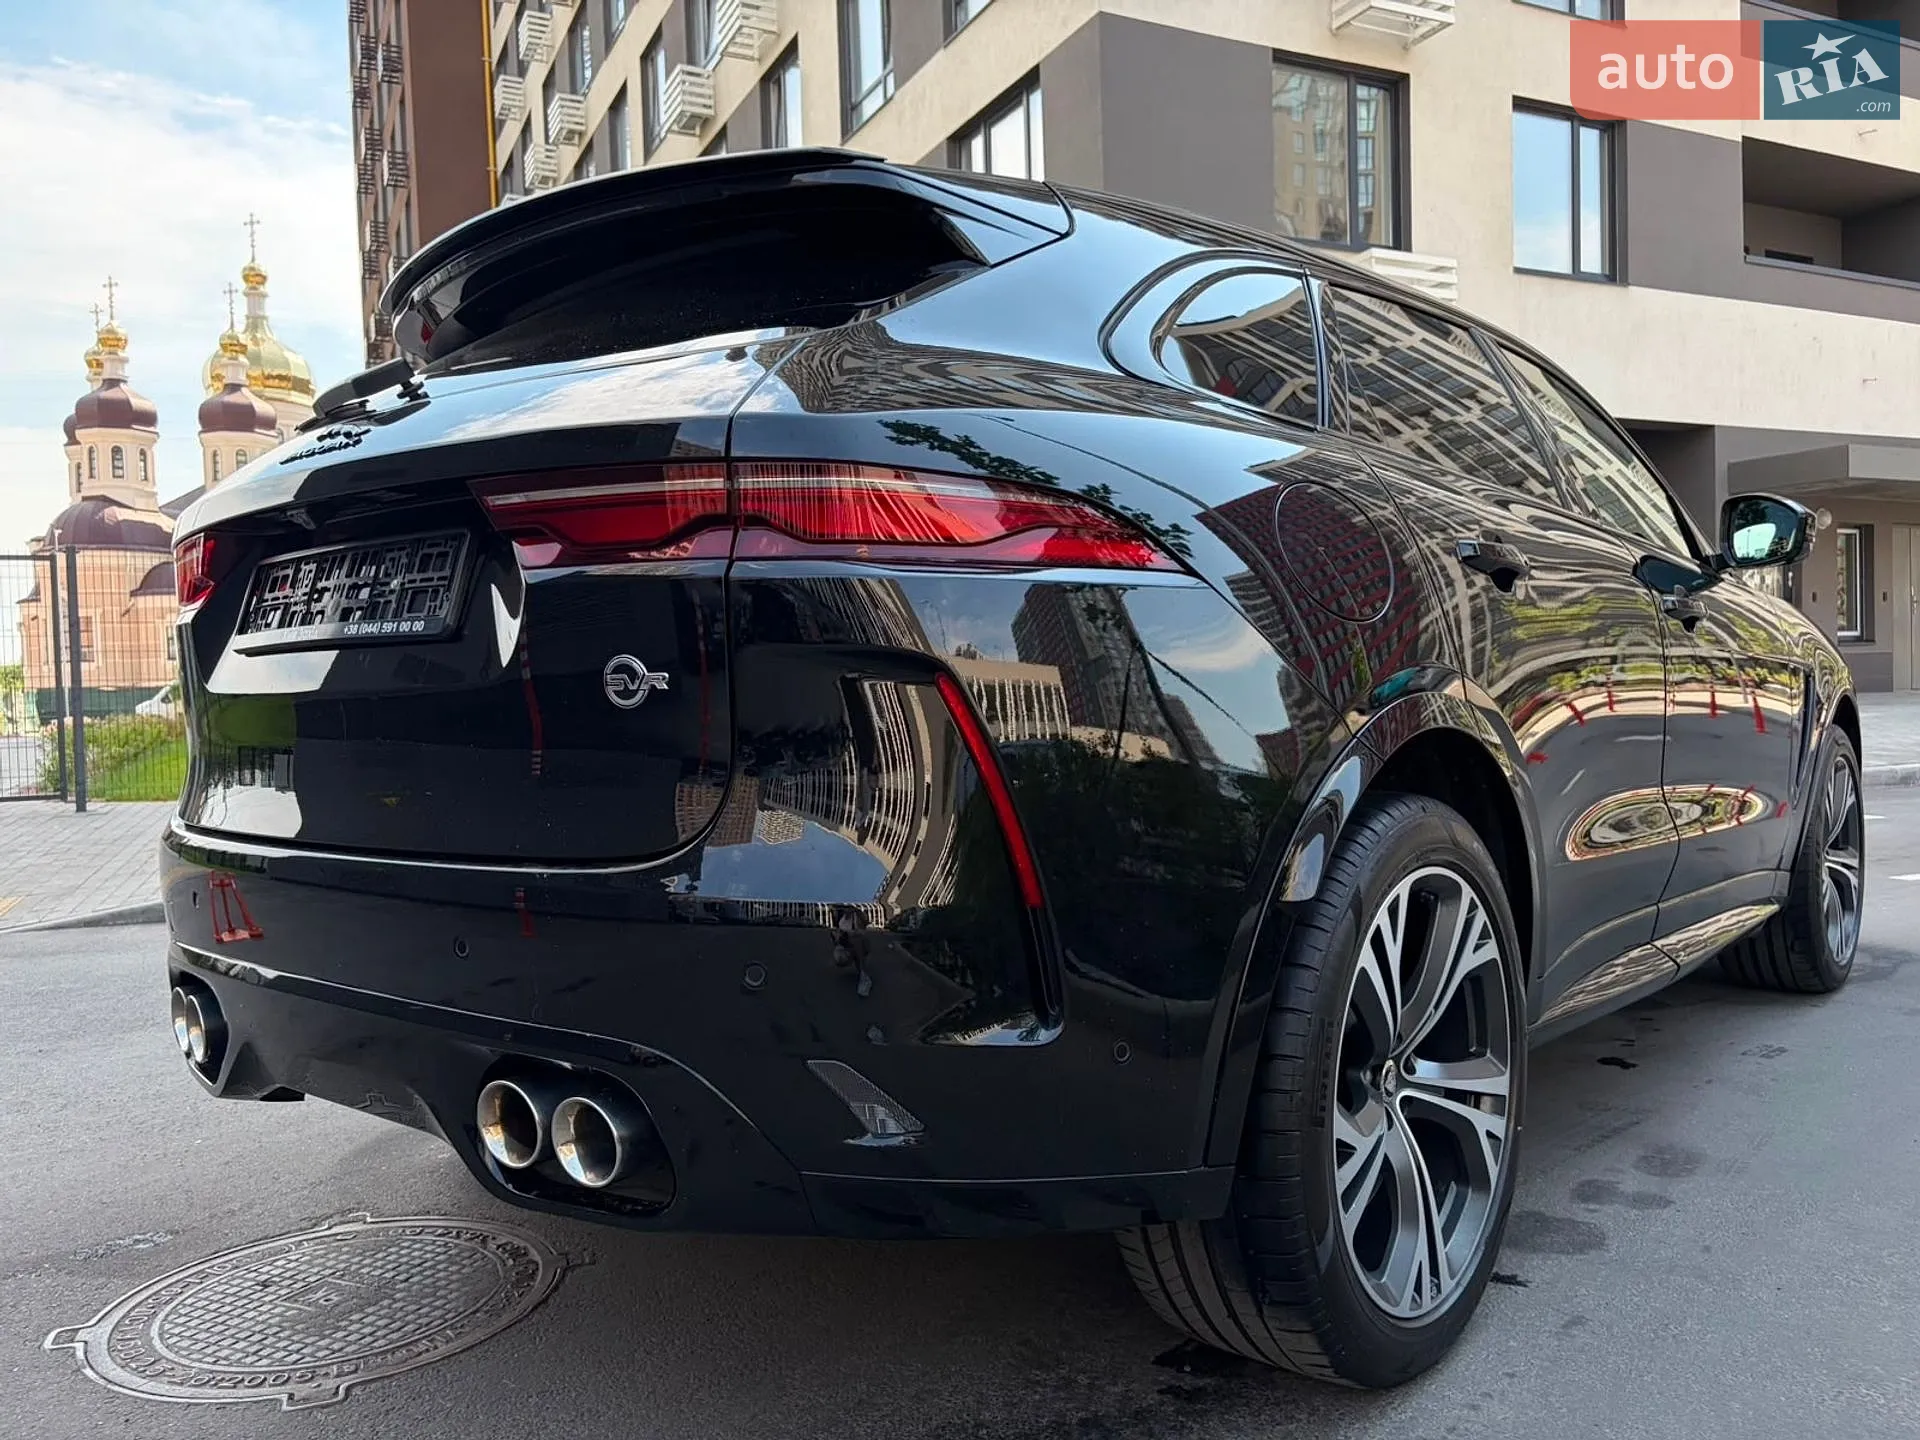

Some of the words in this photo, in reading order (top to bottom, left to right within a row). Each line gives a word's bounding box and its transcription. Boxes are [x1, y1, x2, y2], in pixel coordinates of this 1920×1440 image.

[343, 624, 358, 635] +38
[358, 622, 381, 635] (044)
[381, 621, 398, 633] 591
[399, 620, 411, 632] 00
[412, 620, 425, 632] 00
